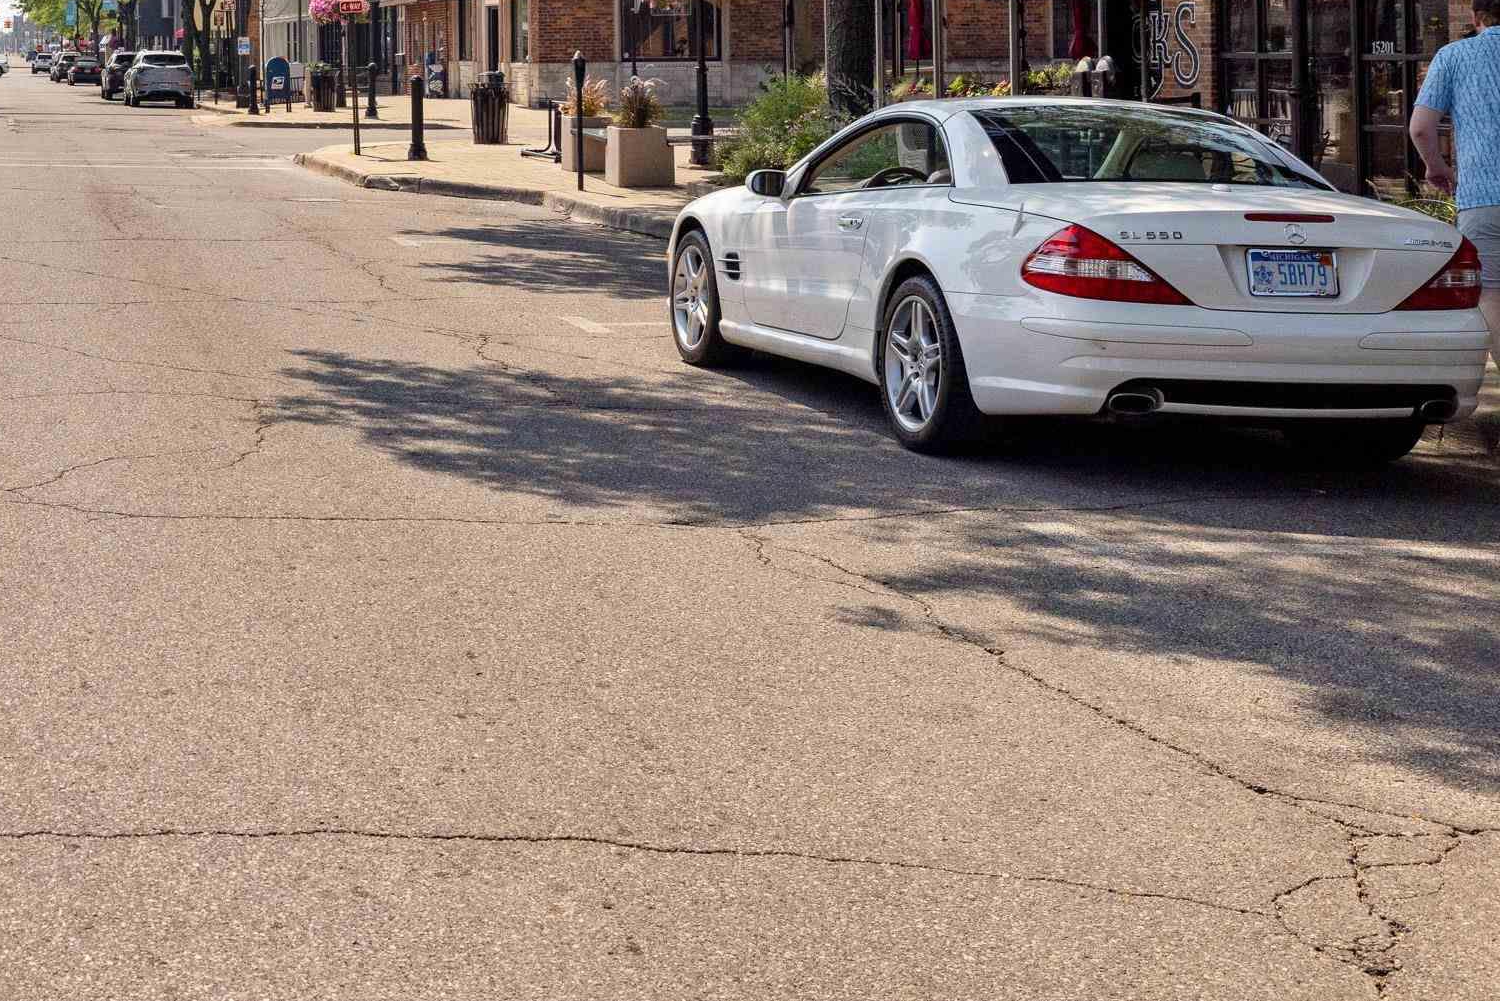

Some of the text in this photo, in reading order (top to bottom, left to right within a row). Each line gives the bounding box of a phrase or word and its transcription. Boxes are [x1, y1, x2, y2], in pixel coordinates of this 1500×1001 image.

[342, 2, 361, 10] 4-WAY
[1371, 41, 1396, 55] 15201
[1119, 231, 1183, 240] SL 550
[1269, 253, 1312, 261] MICHIGAN
[1278, 263, 1328, 287] 5BH79
